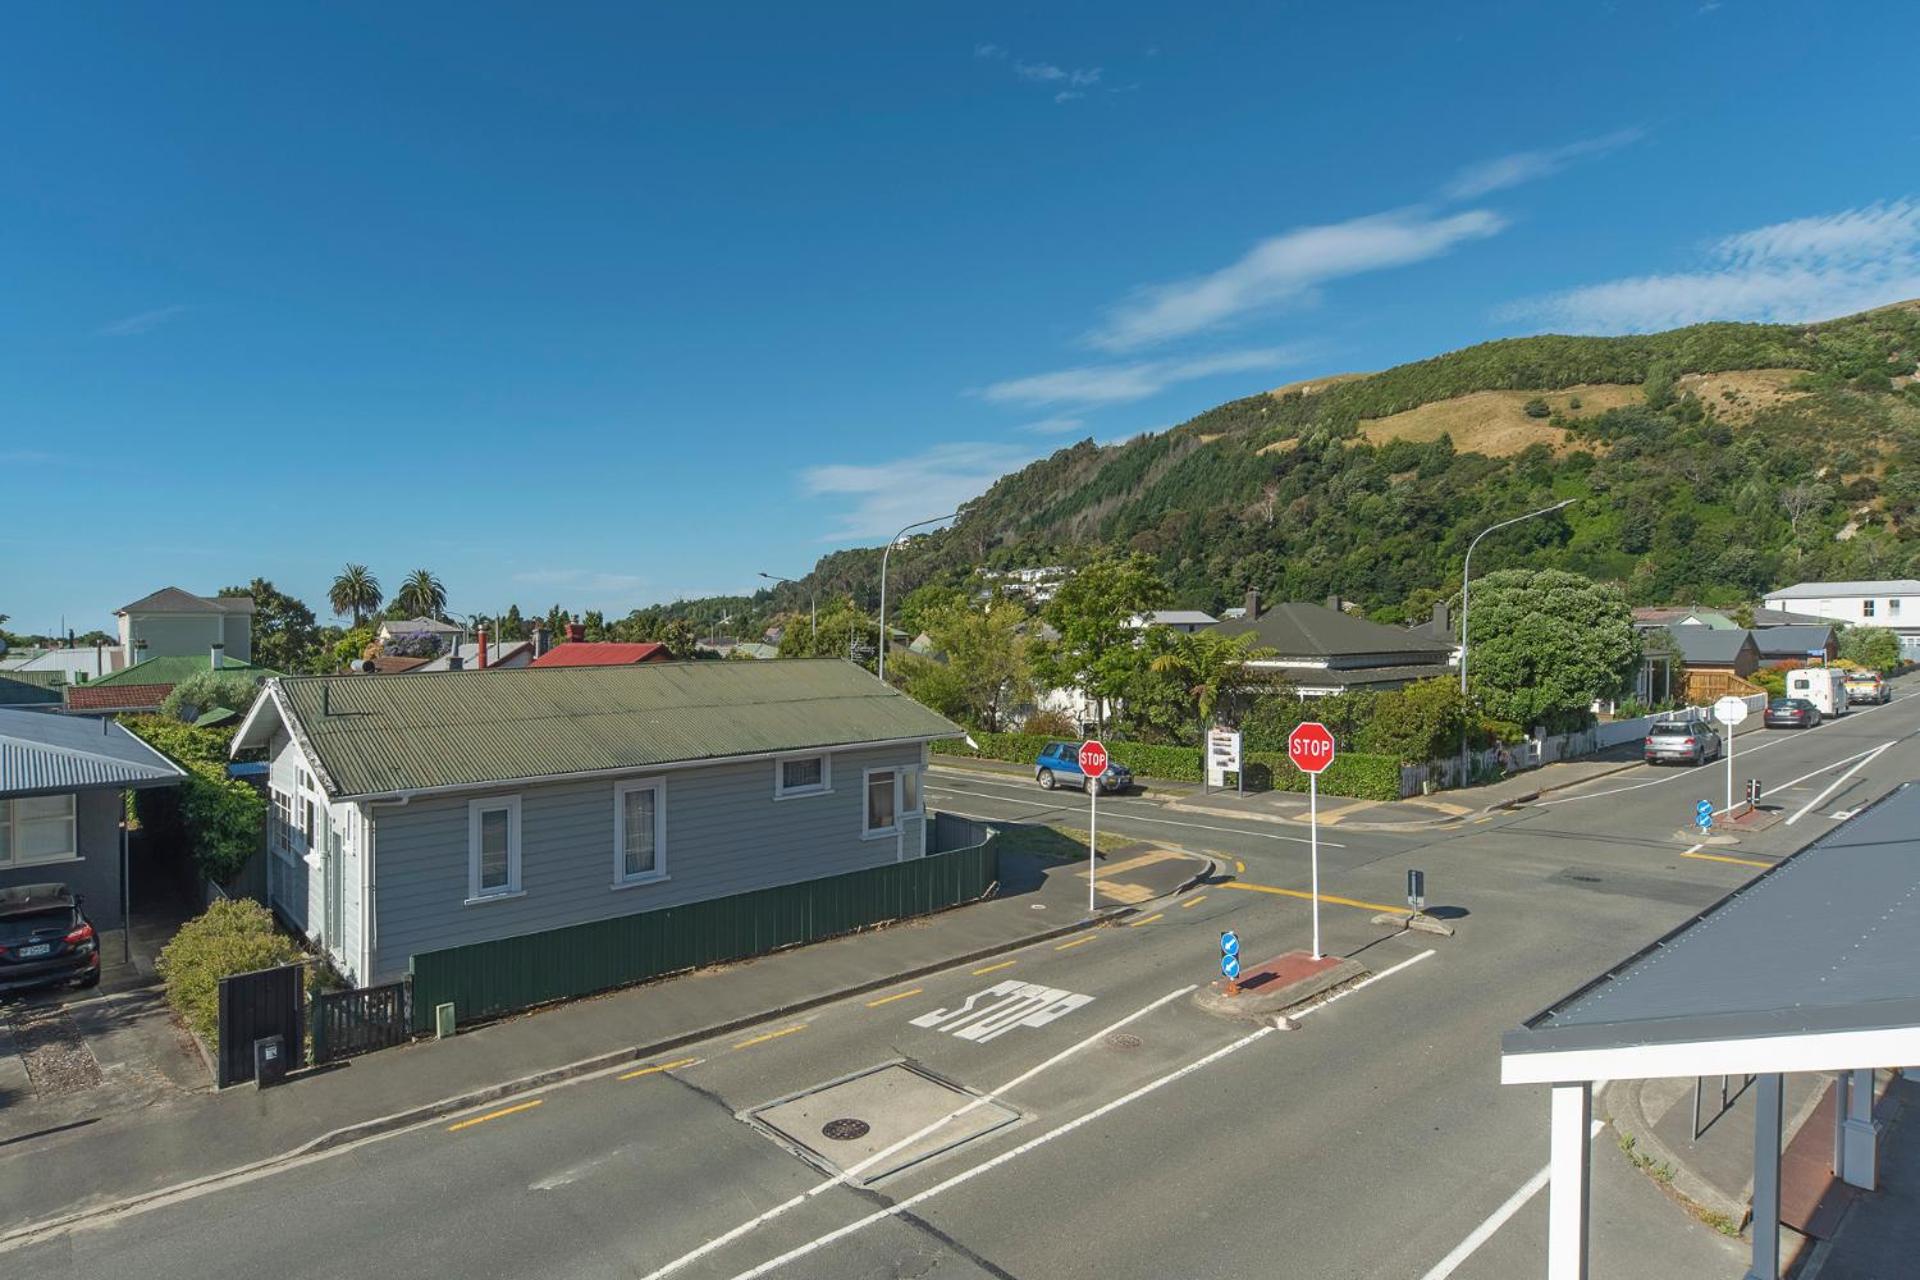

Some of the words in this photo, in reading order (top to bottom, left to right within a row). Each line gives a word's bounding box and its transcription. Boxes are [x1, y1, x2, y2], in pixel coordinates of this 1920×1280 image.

[1292, 738, 1330, 757] STOP
[1081, 752, 1106, 766] STOP
[908, 980, 1097, 1044] STOP
